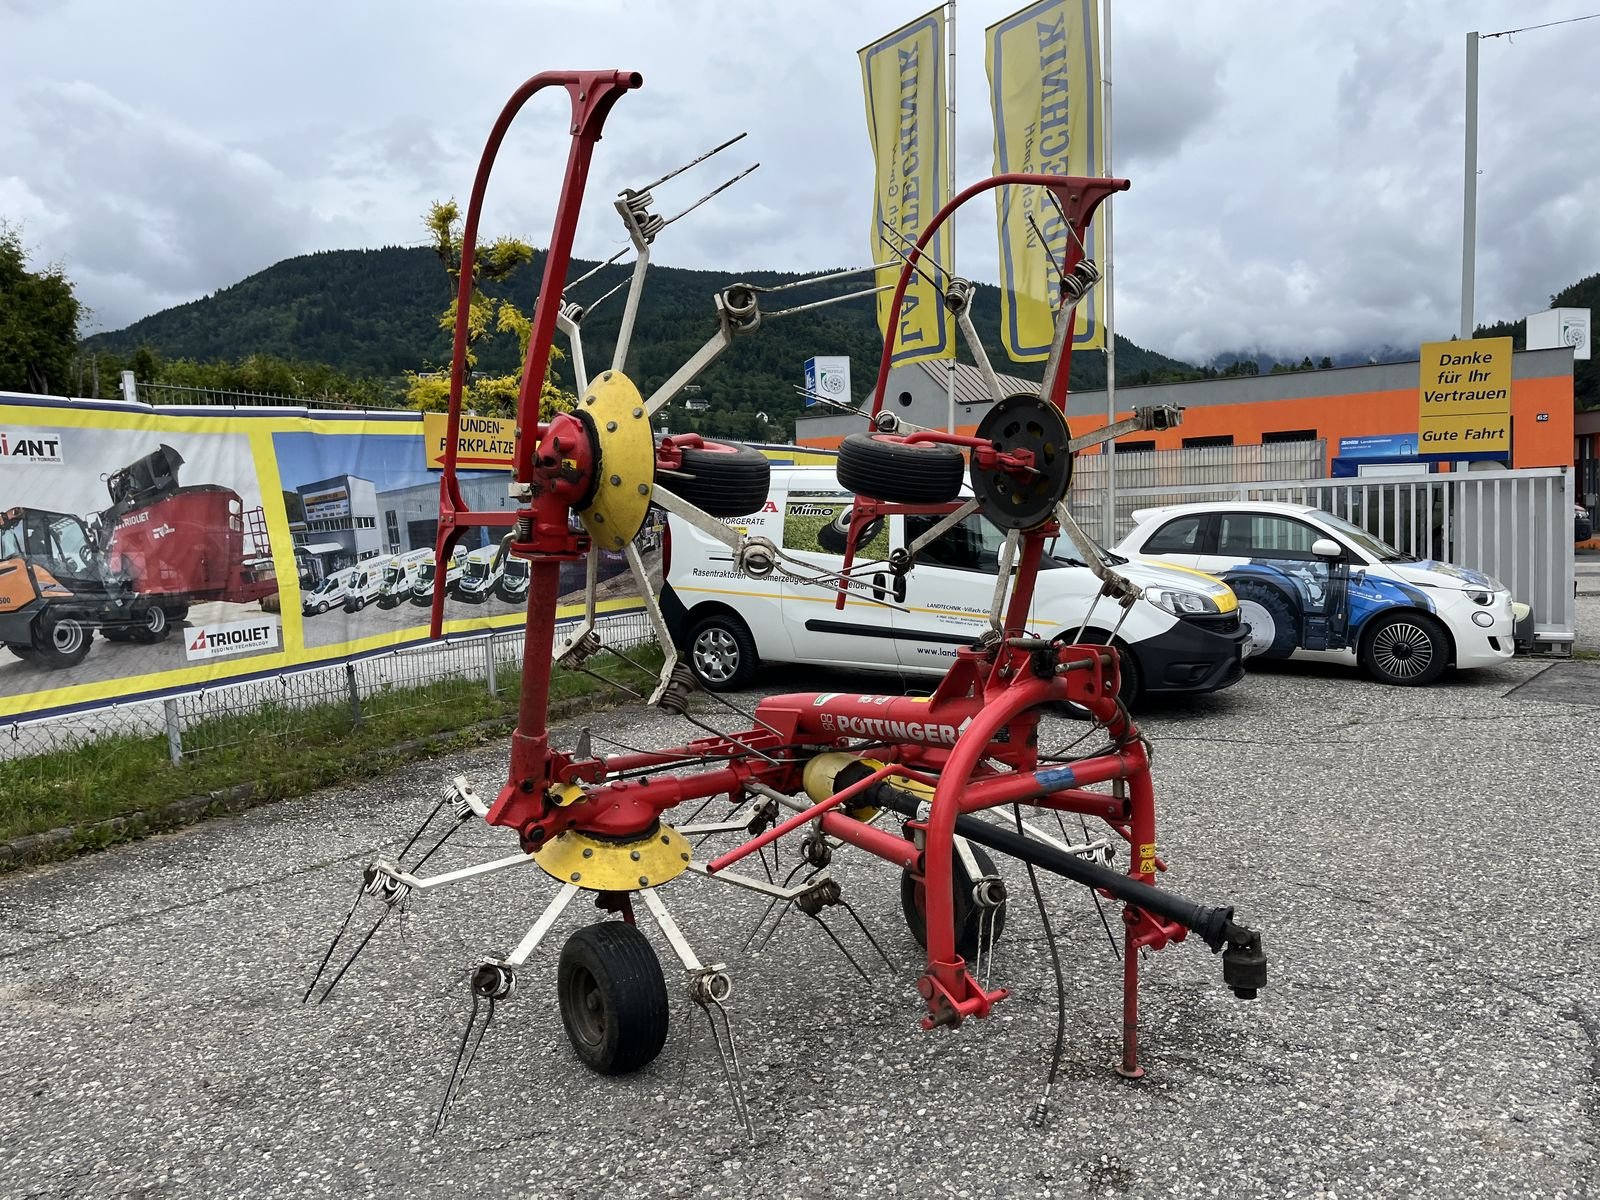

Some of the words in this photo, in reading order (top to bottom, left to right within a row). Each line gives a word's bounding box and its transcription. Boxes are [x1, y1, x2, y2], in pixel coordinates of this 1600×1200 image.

[1440, 352, 1492, 366] Danke
[1437, 371, 1461, 384] für
[1468, 369, 1491, 382] Ihr
[1424, 389, 1507, 402] Vertrauen
[460, 419, 504, 434] UNDEN-
[1422, 430, 1458, 441] Gute
[1465, 428, 1505, 439] Fahrt
[440, 435, 514, 455] PRKPLÄTZE
[206, 626, 270, 648] TRIOLIET
